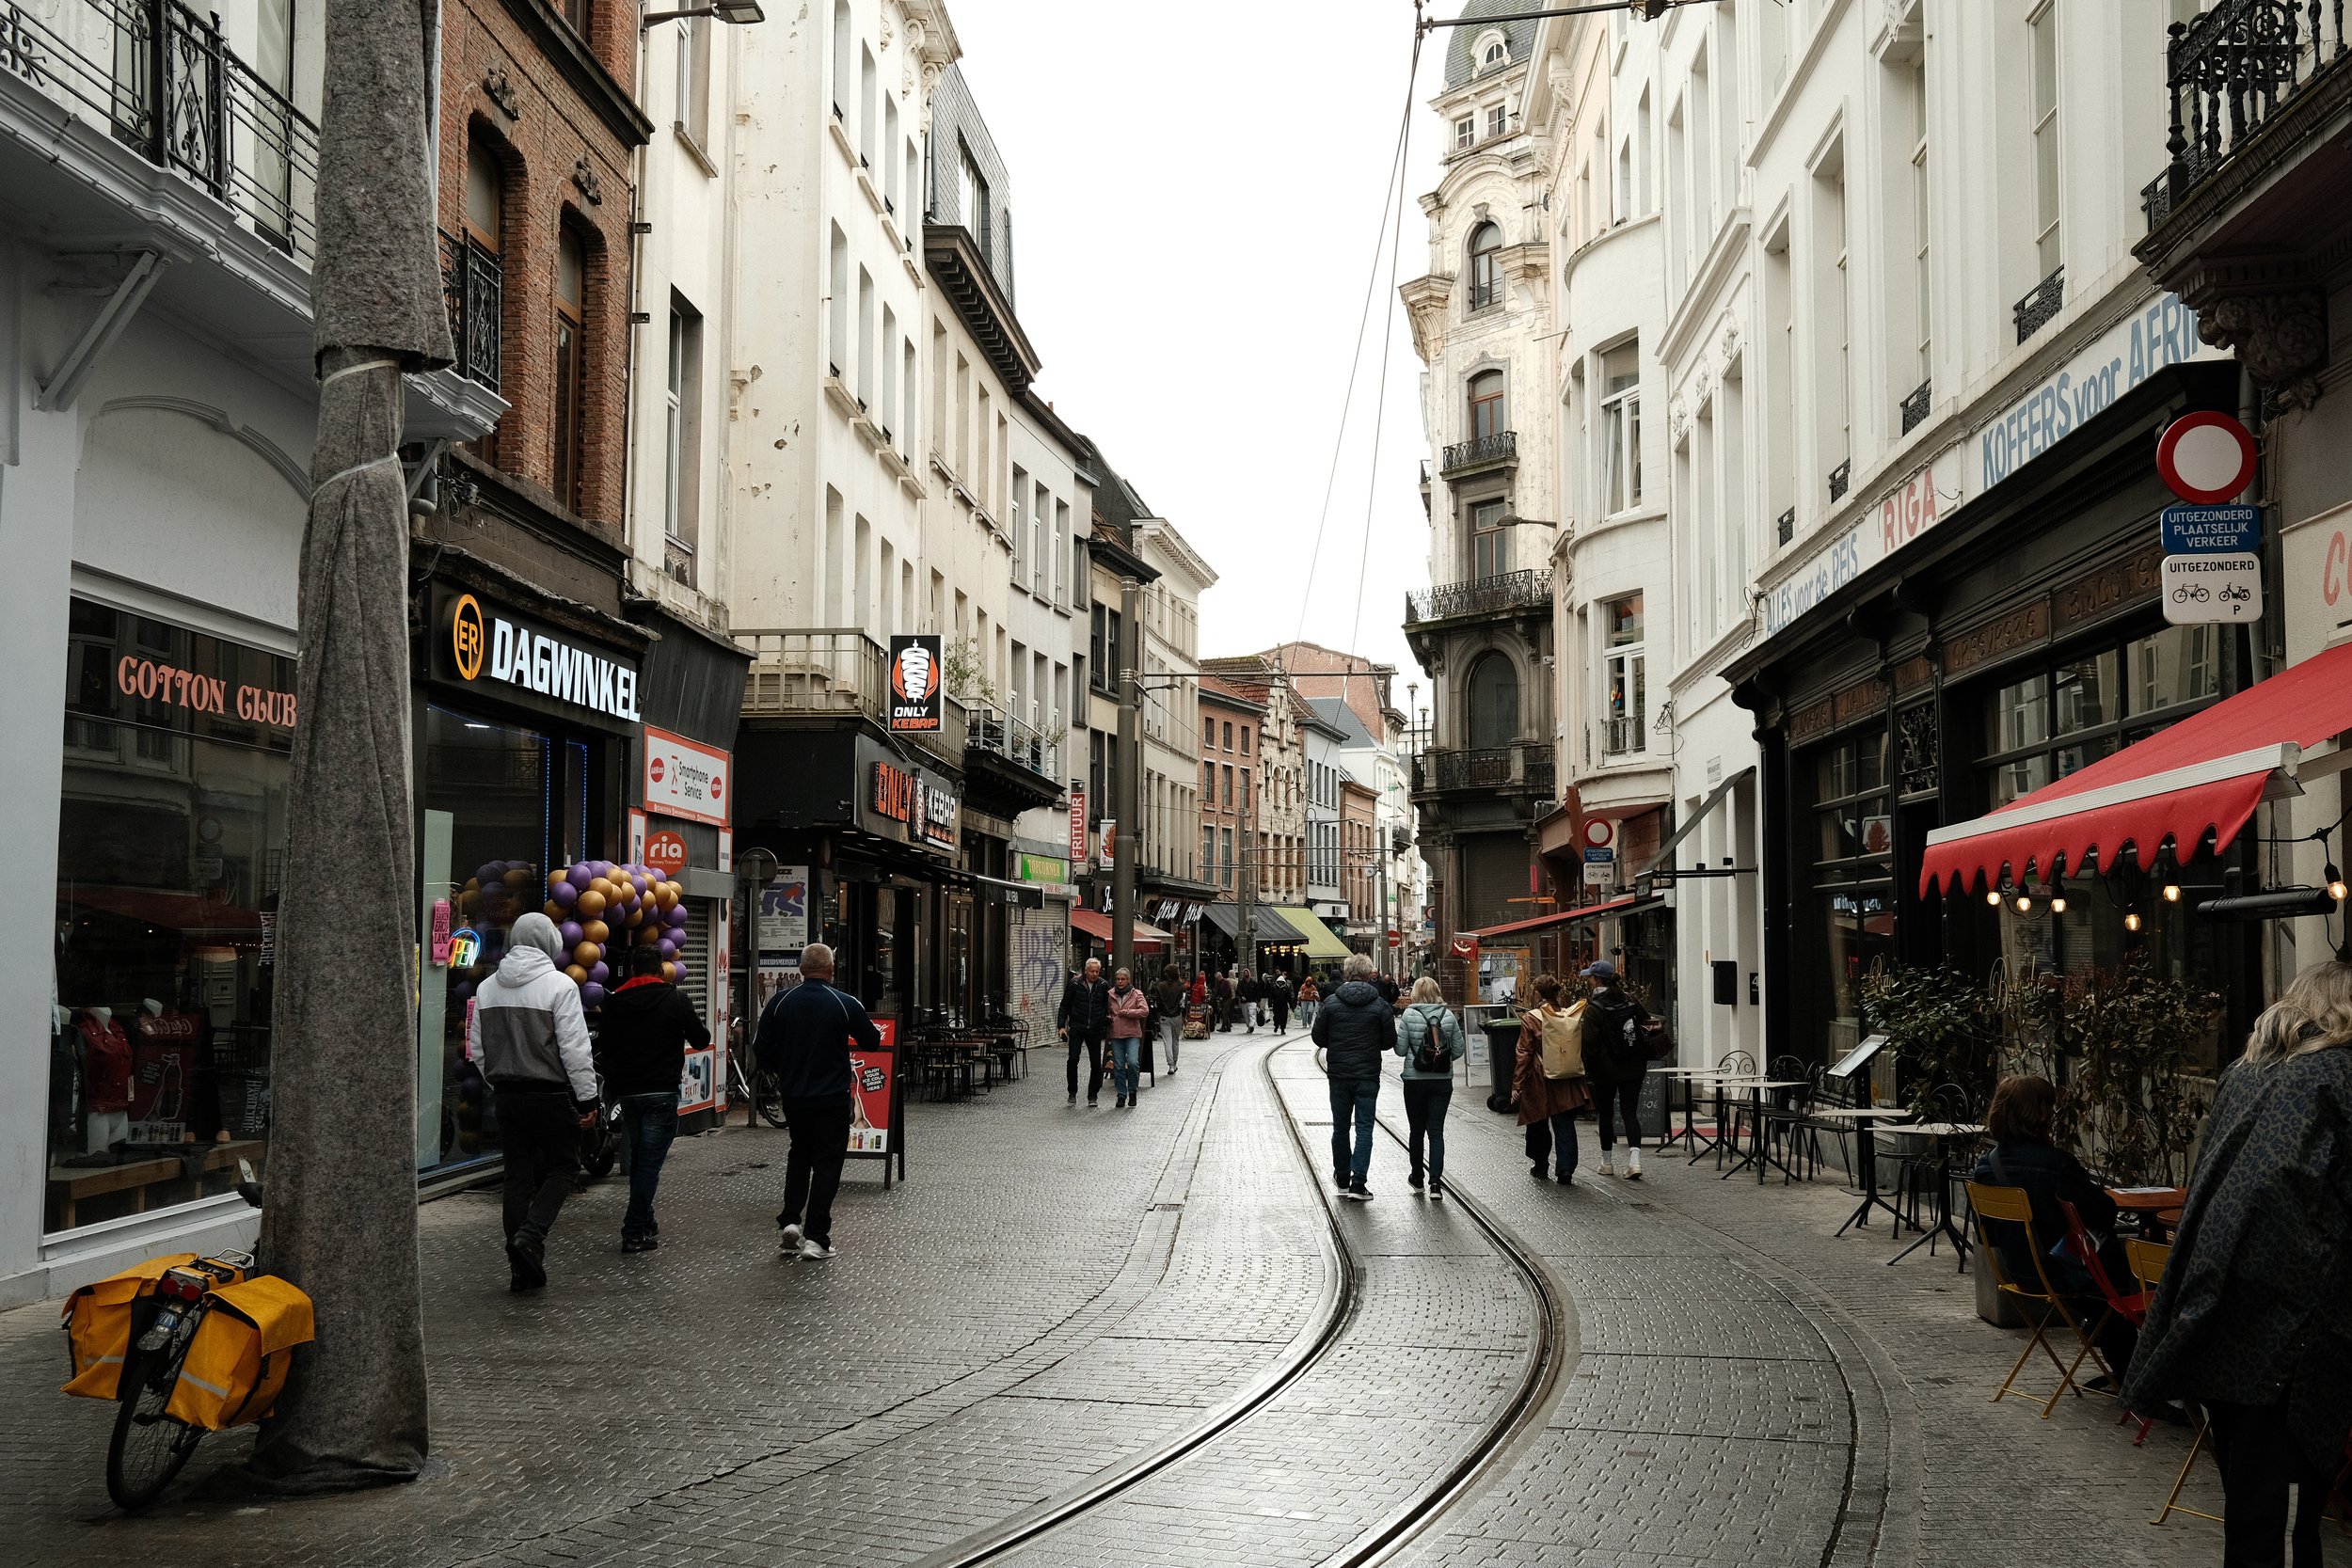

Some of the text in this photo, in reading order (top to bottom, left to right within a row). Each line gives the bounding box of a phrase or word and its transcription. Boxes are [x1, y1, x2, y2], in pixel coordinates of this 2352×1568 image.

[1982, 292, 2198, 491] KOFFERS voor AFRI
[1883, 468, 1936, 555] RIGA
[2169, 509, 2252, 523] UITGEZONDERD
[2173, 523, 2249, 535] PLAATSELIJK
[2186, 535, 2238, 547] VERKEER
[2169, 561, 2254, 573] UITGEZONDERD
[1766, 532, 1858, 639] ALLES voor de REIS
[2068, 551, 2161, 620] BIJOUTER
[2233, 605, 2241, 615] P
[491, 618, 641, 722] DAGWINKEL
[118, 656, 297, 727] COTTON CLUB
[894, 706, 929, 717] ONLY
[892, 718, 938, 729] KEBAP
[678, 761, 708, 784] Smartphone
[684, 782, 702, 800] Service
[878, 762, 956, 828] ONLY KEBAP
[1072, 797, 1083, 859] FRITUUR
[649, 835, 682, 858] ria
[448, 937, 478, 968] OPEN
